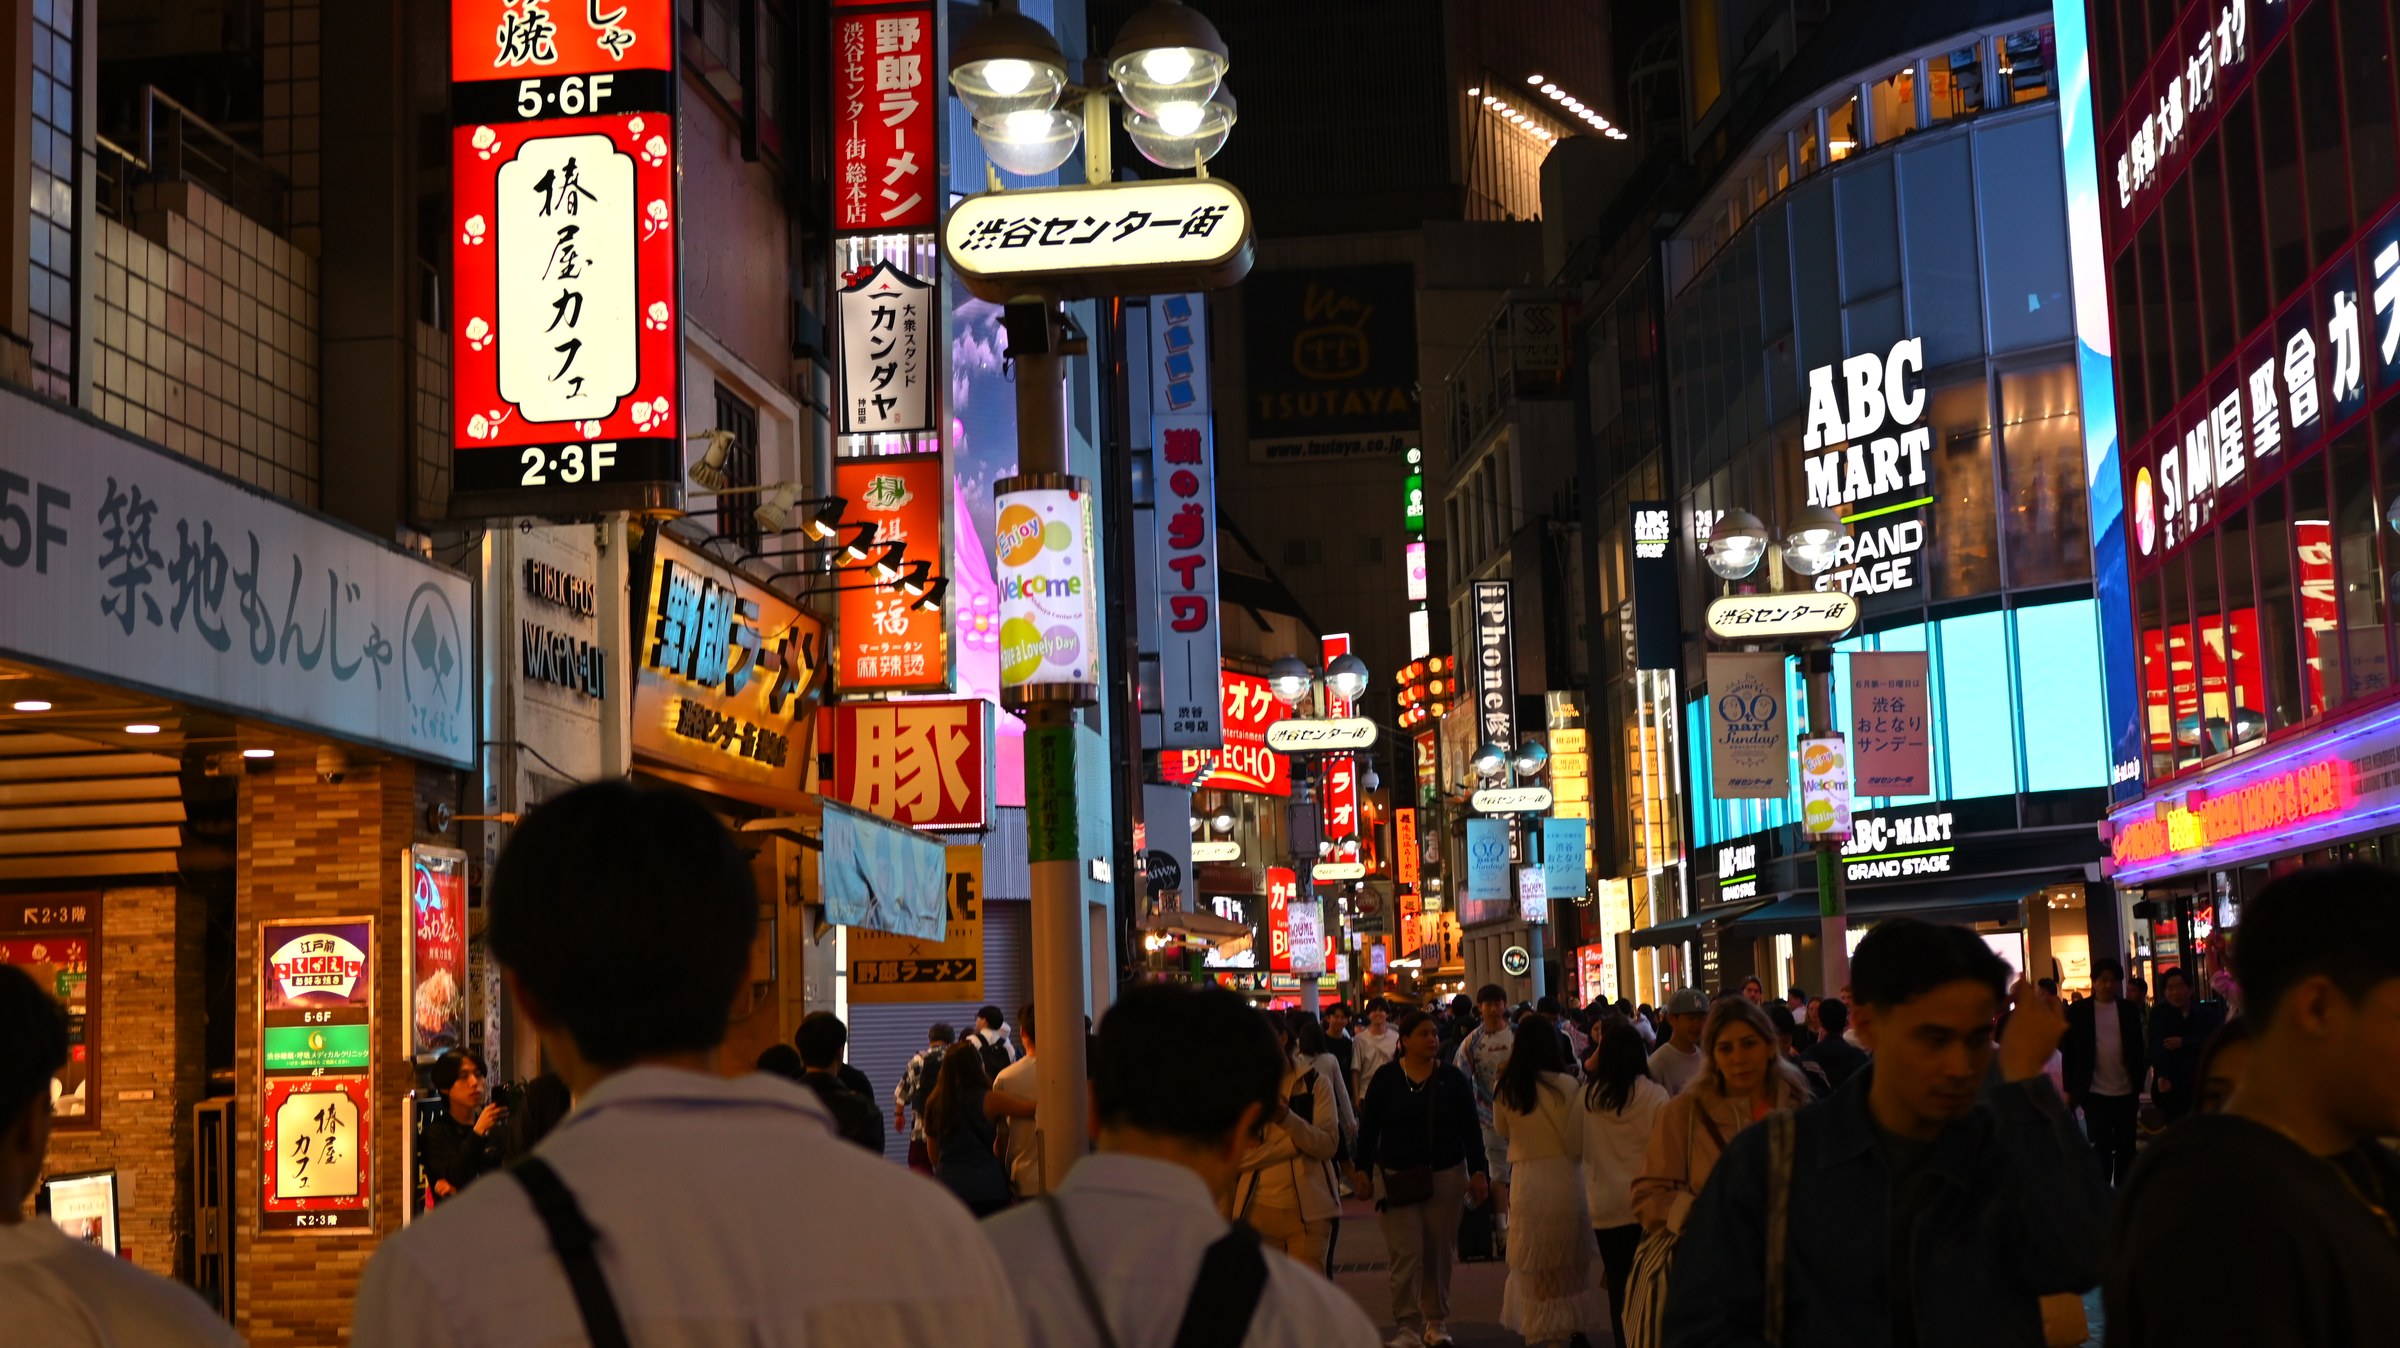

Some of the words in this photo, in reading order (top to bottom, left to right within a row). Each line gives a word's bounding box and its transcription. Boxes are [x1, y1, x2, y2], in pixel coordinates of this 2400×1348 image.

[494, 0, 558, 66] 焼
[875, 16, 922, 222] 野郎ラーメン
[960, 205, 1229, 250] 渋谷センター街
[533, 157, 598, 398] 椿屋カフェ
[870, 305, 898, 420] カンダヤ
[903, 304, 916, 388] 大衆スタンド
[1257, 386, 1410, 421] TSUTAYA
[1804, 337, 1926, 451] ABC
[1266, 435, 1403, 458] www.tsutaya.co.jp
[1804, 427, 1930, 508] MART
[1635, 510, 1668, 528] ABC
[999, 516, 1040, 560] Enjoy
[97, 476, 393, 690] 築地もんじゃ
[529, 560, 569, 606] PUBLIC
[570, 575, 597, 616] HOUS
[872, 518, 908, 636] 楊福
[999, 574, 1081, 604] Welcome
[1815, 558, 1912, 598] STAGE
[1715, 602, 1848, 626] 渋谷センター街
[522, 619, 580, 689] WAGON
[651, 558, 822, 722] 野郎ラーメン
[859, 641, 923, 654] マーラータン
[1022, 637, 1054, 662] Lovely
[1055, 635, 1077, 651] Day!
[1479, 586, 1507, 710] iPhone
[1178, 706, 1203, 718] 渋谷
[1221, 679, 1273, 723] オケ
[1872, 696, 1905, 713] 渋谷
[1173, 720, 1209, 733] 2号店
[1222, 728, 1265, 743] ntertainment
[1271, 726, 1370, 743] 渋谷センター街
[1719, 731, 1780, 749] Sunday
[1857, 716, 1921, 733] おとなり
[1805, 751, 1832, 772] Enjoy
[1857, 735, 1922, 753] サンデー
[851, 705, 971, 822] 豚
[1223, 745, 1276, 784] ECHO
[1804, 779, 1849, 793] Welcome
[1841, 813, 1953, 856] ABC-MART
[1147, 865, 1177, 880] AIWA
[1847, 858, 1901, 881] GRAND
[1902, 855, 1951, 875] STAGE
[301, 939, 336, 954] 江戸前
[276, 956, 360, 979] こてがえし
[857, 959, 973, 982] 野郎ラーメン
[311, 1068, 325, 1077] 4F
[314, 1104, 345, 1166] 椿屋
[291, 1133, 311, 1190] カフェ
